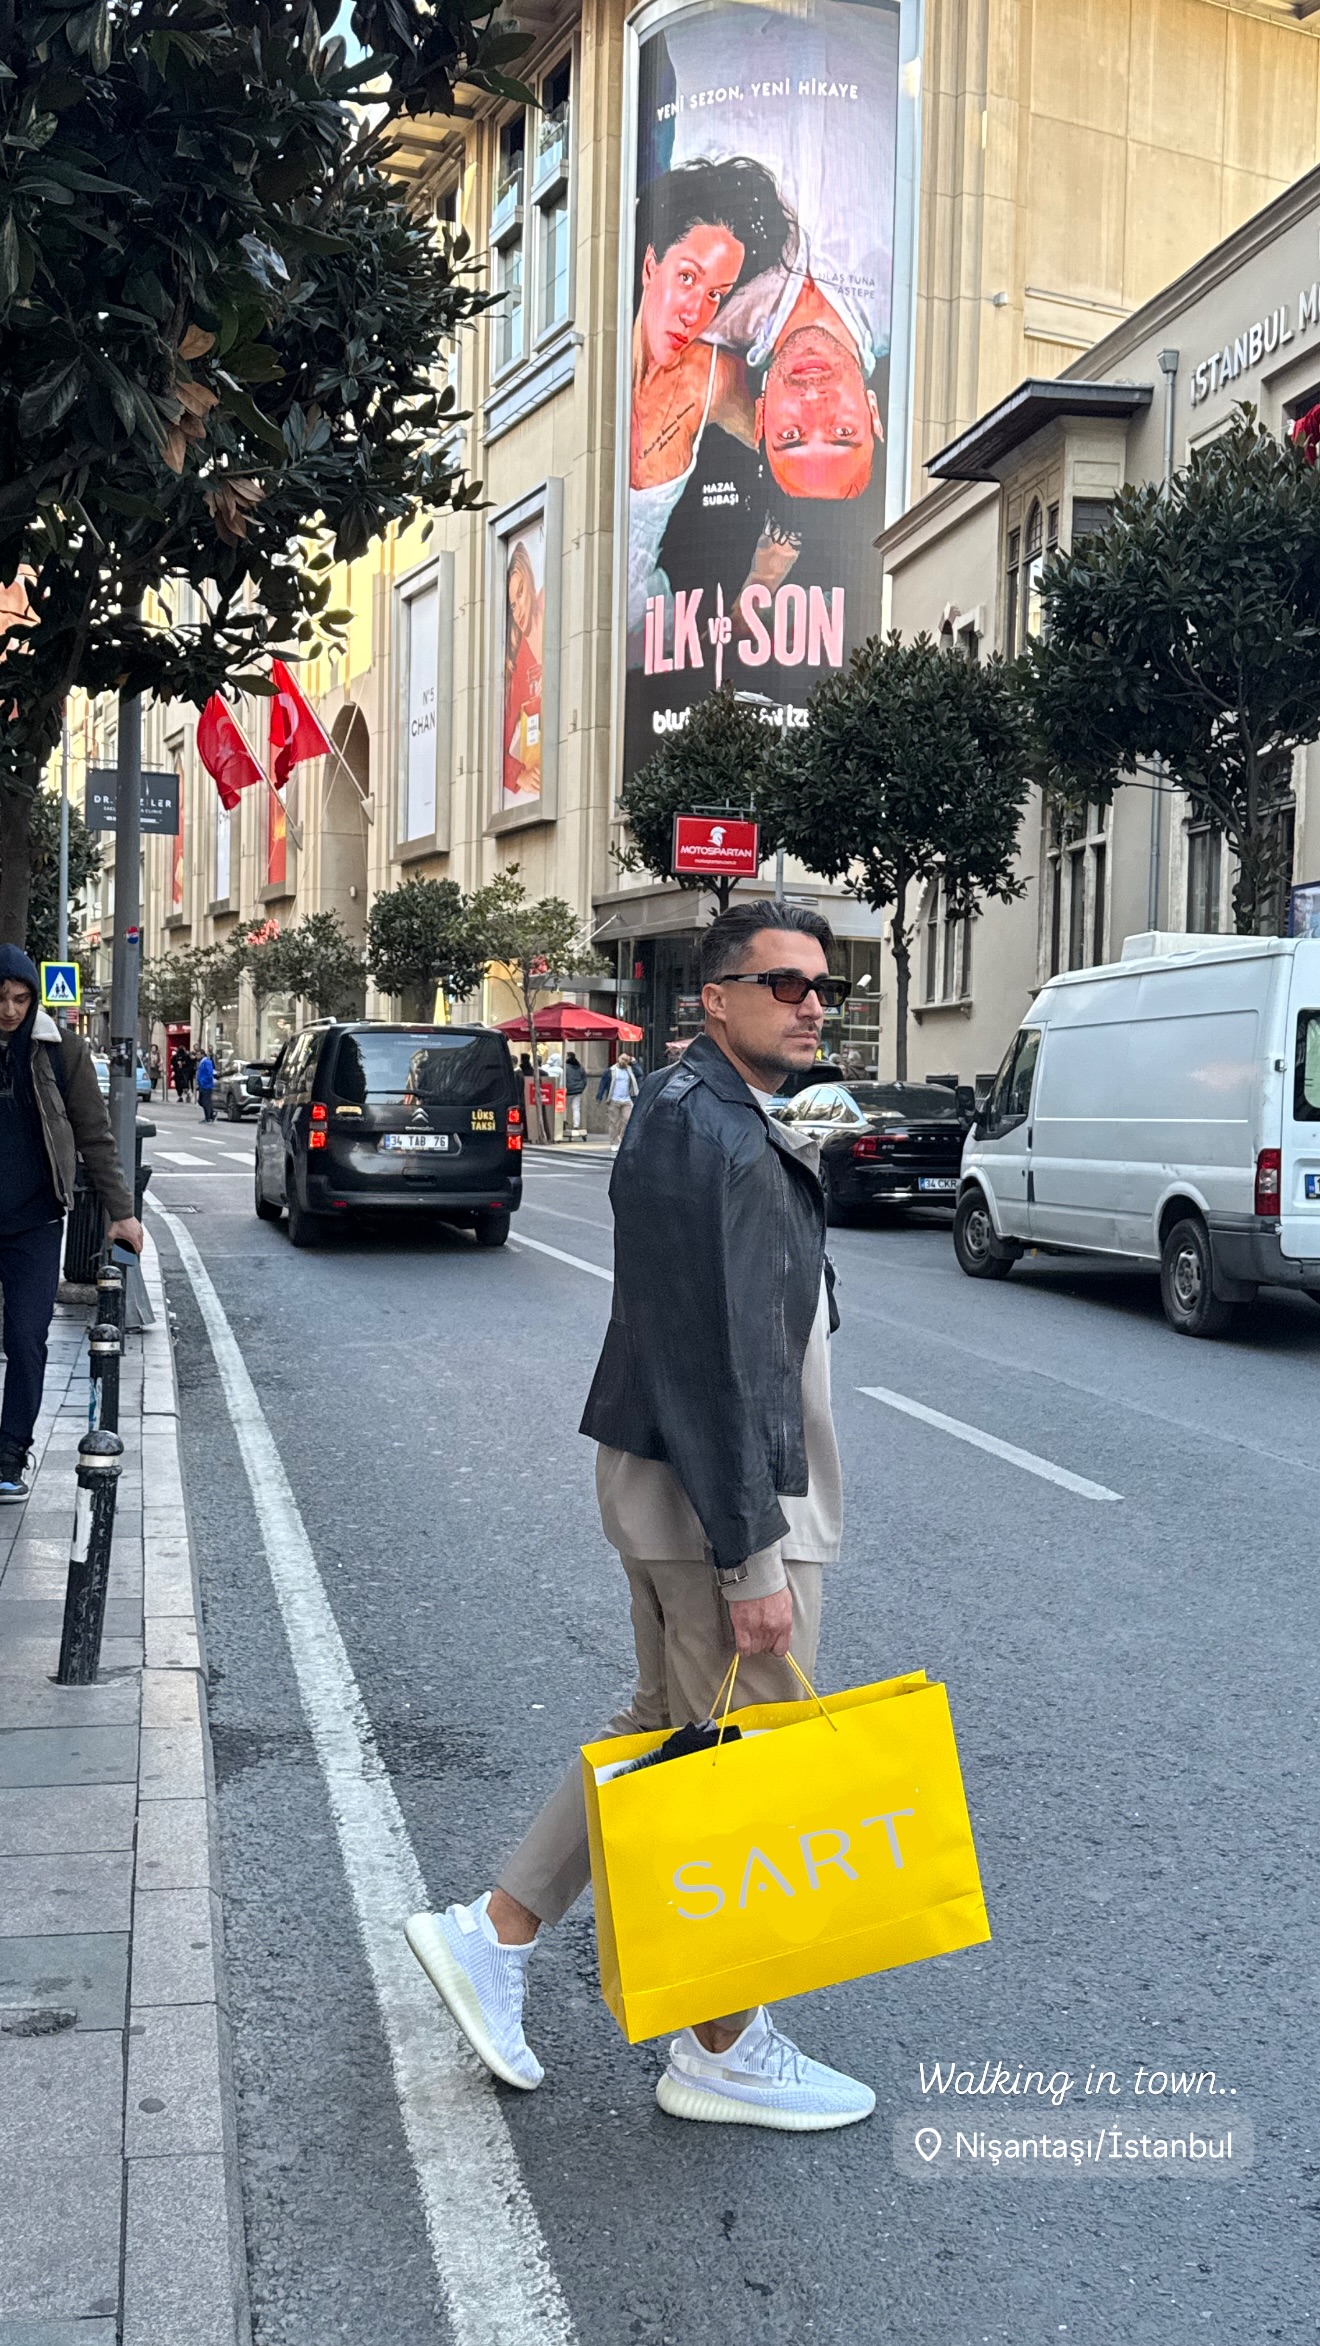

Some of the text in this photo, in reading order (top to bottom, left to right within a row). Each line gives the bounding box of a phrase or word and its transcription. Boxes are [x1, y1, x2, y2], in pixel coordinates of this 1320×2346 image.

[656, 77, 859, 122] YENİ SEZON, YENİ HİKAYE
[848, 274, 876, 286] TUNA
[837, 286, 876, 299] ASTEPE
[1190, 282, 1320, 406] İSTANBUL M
[703, 481, 737, 494] HAZAL
[702, 493, 739, 507] SUBAŞI
[708, 616, 732, 645] ve
[738, 583, 845, 667] SON
[680, 845, 753, 858] MOTOSPARTAN
[471, 1108, 495, 1120] LÜKS
[470, 1118, 496, 1131] TAKSİ
[391, 1136, 446, 1147] 34 TAB 76
[925, 1179, 957, 1189] 34 CKR
[672, 1807, 915, 1920] SART
